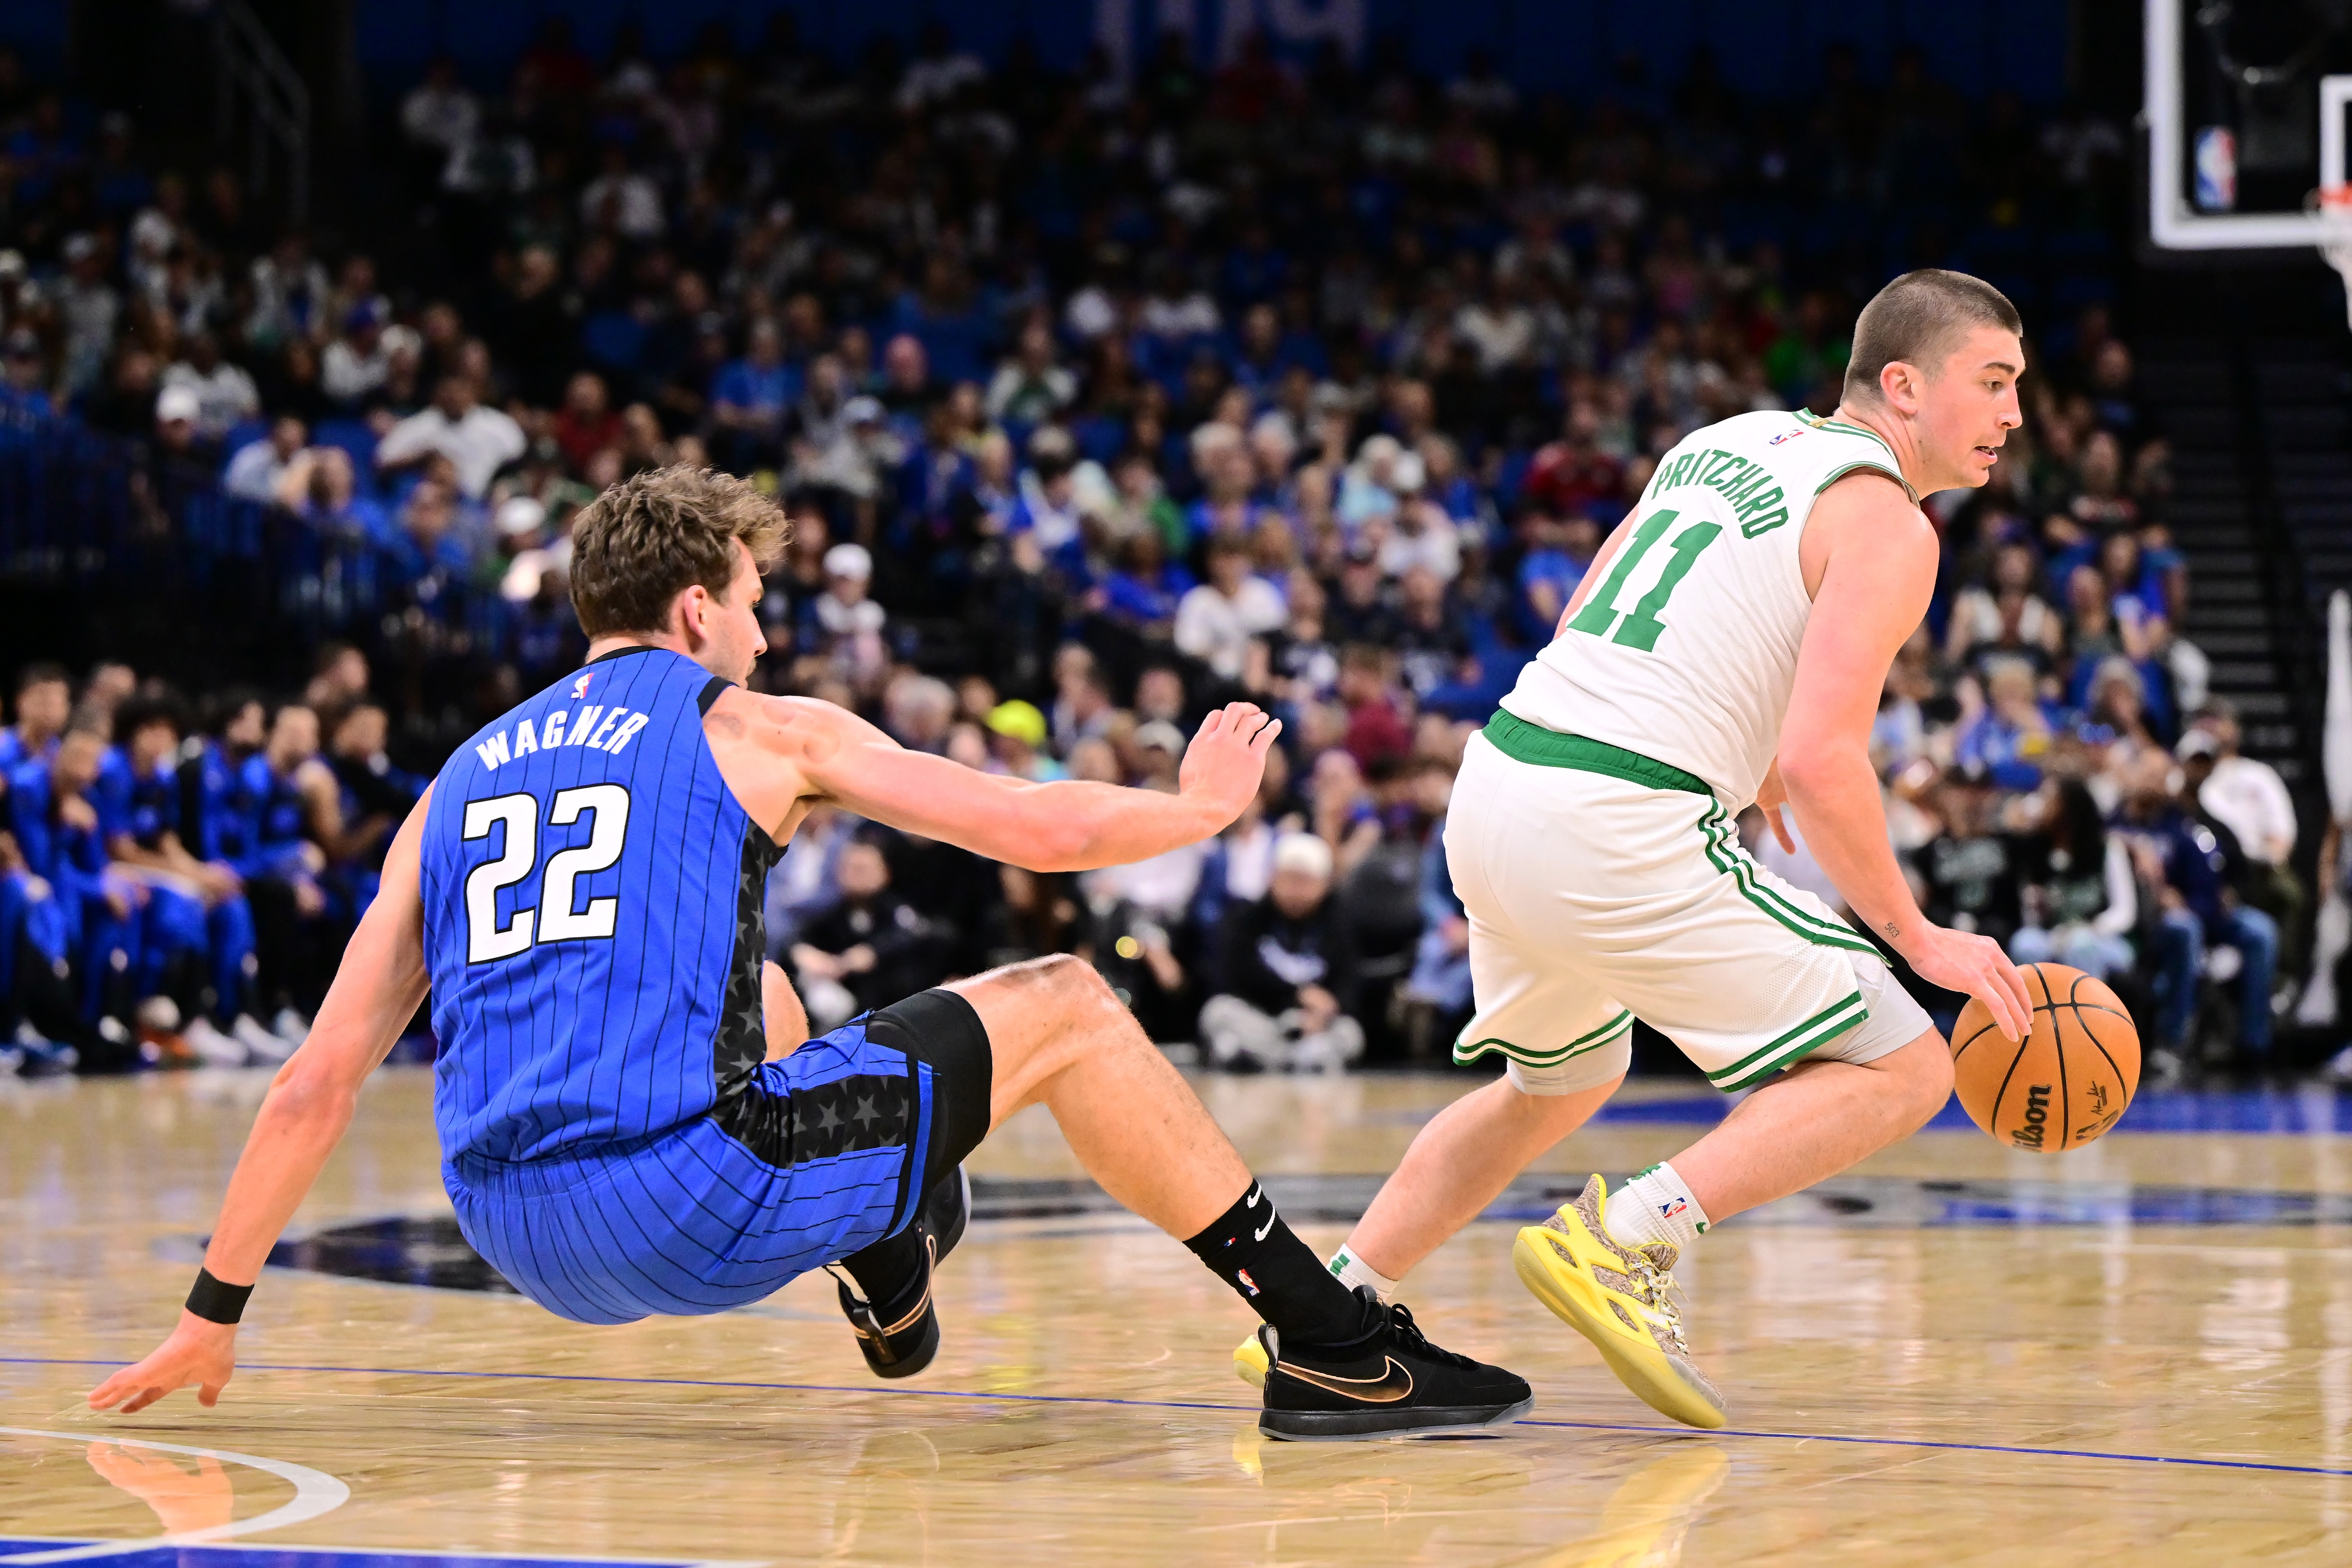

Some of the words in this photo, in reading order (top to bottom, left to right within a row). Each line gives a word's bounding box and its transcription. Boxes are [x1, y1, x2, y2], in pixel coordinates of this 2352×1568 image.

[1652, 449, 1789, 539] PRITCHARD
[1566, 509, 1723, 653] 11
[476, 705, 650, 771] WAGNER
[461, 782, 632, 967] 22
[1884, 922, 1900, 938] 503
[2010, 1084, 2052, 1153] ilson
